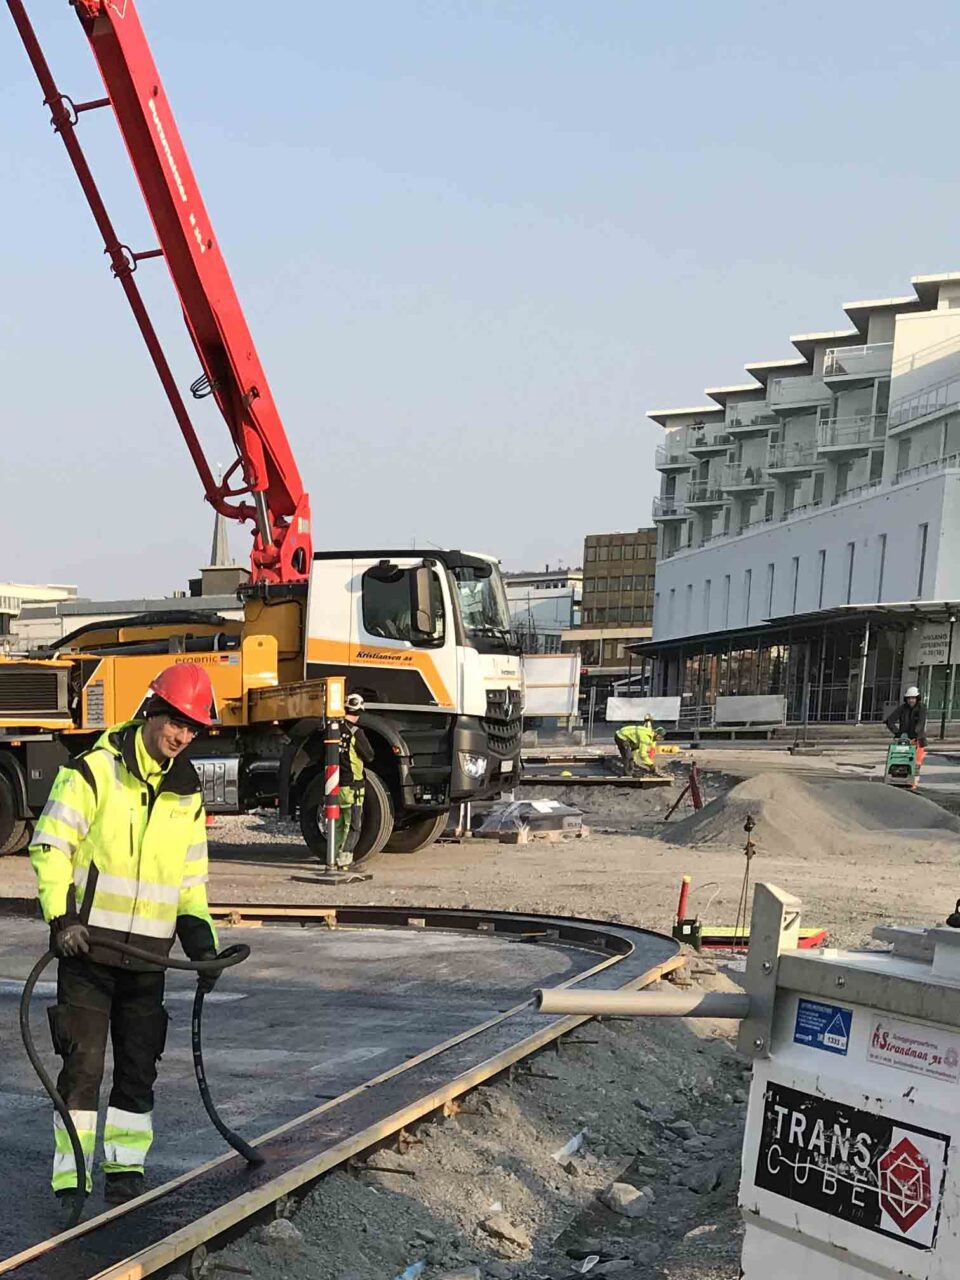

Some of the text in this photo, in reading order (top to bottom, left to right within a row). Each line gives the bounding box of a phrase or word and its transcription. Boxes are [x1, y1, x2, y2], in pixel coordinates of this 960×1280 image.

[355, 650, 402, 661] Kristiansen
[773, 1104, 873, 1170] TRANS
[766, 1144, 869, 1208] CUBE
